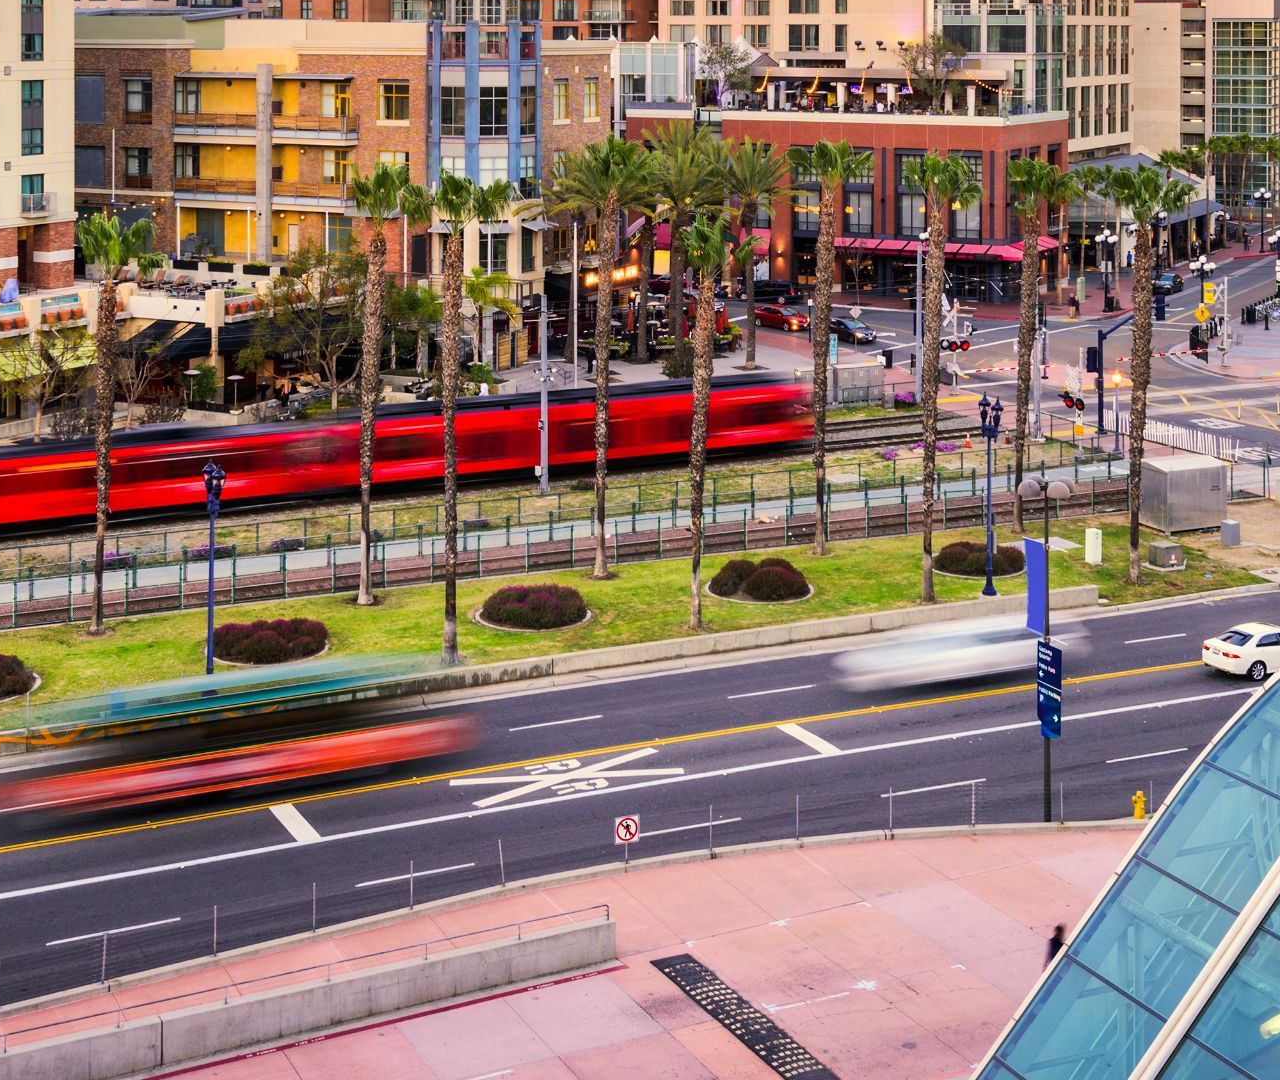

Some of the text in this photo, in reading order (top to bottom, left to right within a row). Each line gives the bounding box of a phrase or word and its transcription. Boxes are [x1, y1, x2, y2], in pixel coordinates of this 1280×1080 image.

[1039, 645, 1053, 657] Gaslamp
[1039, 651, 1051, 662] Quarter
[1048, 666, 1056, 674] Park
[1039, 686, 1061, 702] Public Parking
